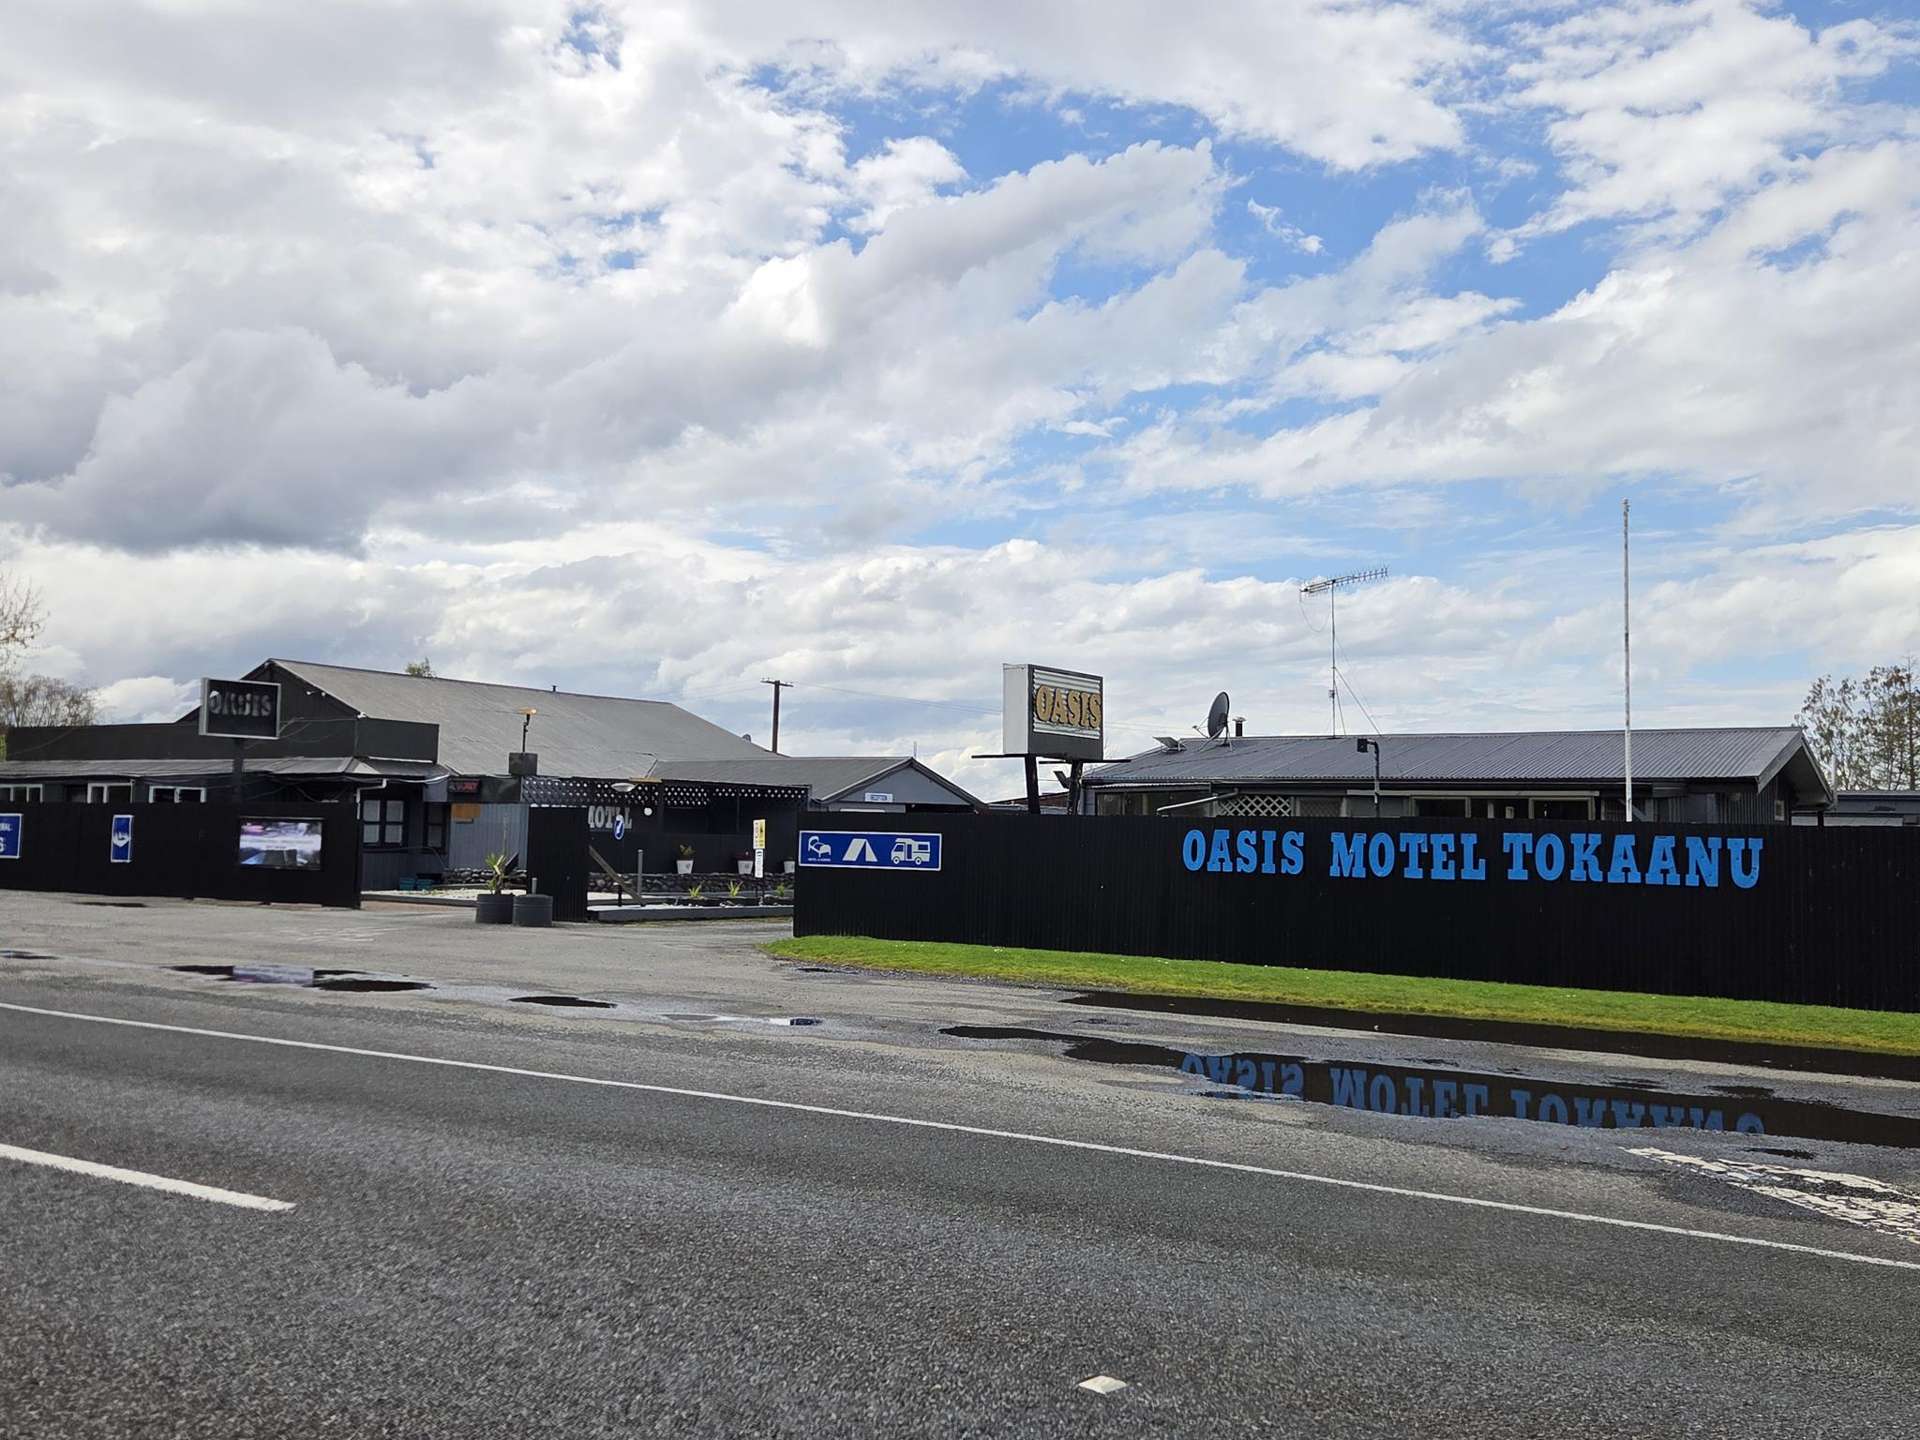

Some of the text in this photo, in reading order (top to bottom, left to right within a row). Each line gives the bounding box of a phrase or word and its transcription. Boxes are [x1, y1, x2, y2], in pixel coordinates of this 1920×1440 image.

[1036, 684, 1102, 729] OASIS
[1183, 829, 1763, 888] OASIS MOTEL TOKAANU
